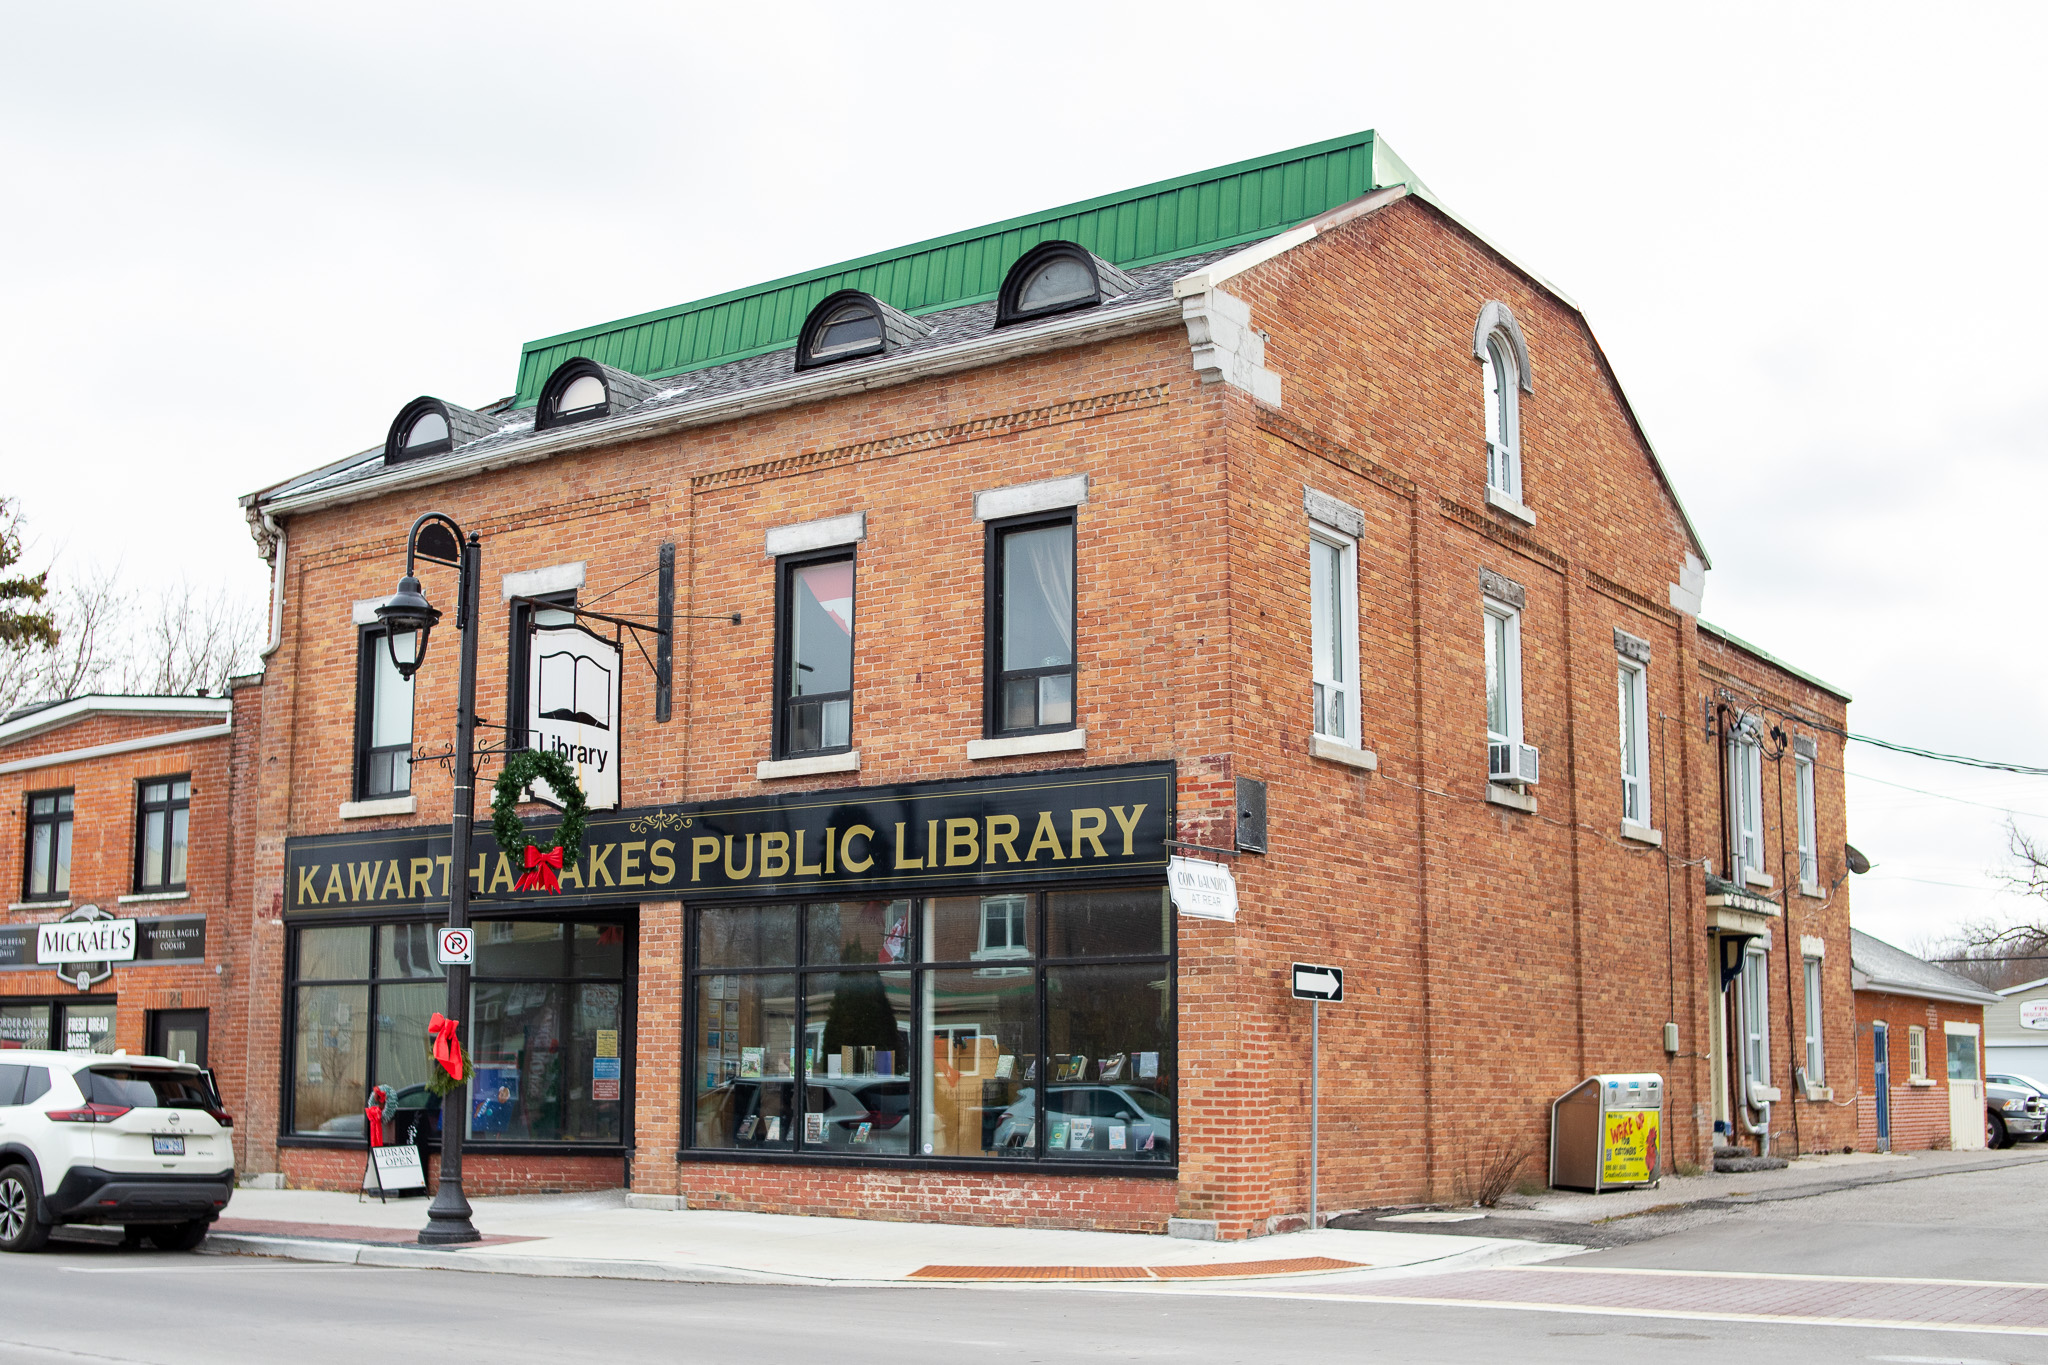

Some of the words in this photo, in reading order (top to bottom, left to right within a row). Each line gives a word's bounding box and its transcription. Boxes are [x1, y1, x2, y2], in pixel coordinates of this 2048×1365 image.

[539, 732, 608, 773] Library
[296, 851, 515, 905] KAWARTHA
[530, 837, 677, 890] AKES
[690, 823, 876, 882] PUBLIC
[893, 803, 1149, 871] LIBRARY
[1177, 871, 1196, 887] COIN
[1197, 873, 1228, 892] LAUNDRY
[1191, 893, 1201, 904] AT
[1202, 894, 1221, 906] REAR
[42, 923, 131, 954] MICKAËL'S
[176, 927, 200, 938] BAGELS
[159, 940, 186, 951] COOKIES
[67, 1016, 88, 1033] FRESH
[87, 1016, 109, 1033] BREAD
[67, 1032, 91, 1049] BAGELS
[1610, 1117, 1633, 1145] WAKE
[375, 1145, 417, 1158] LIBRARY
[385, 1156, 413, 1166] OPEN
